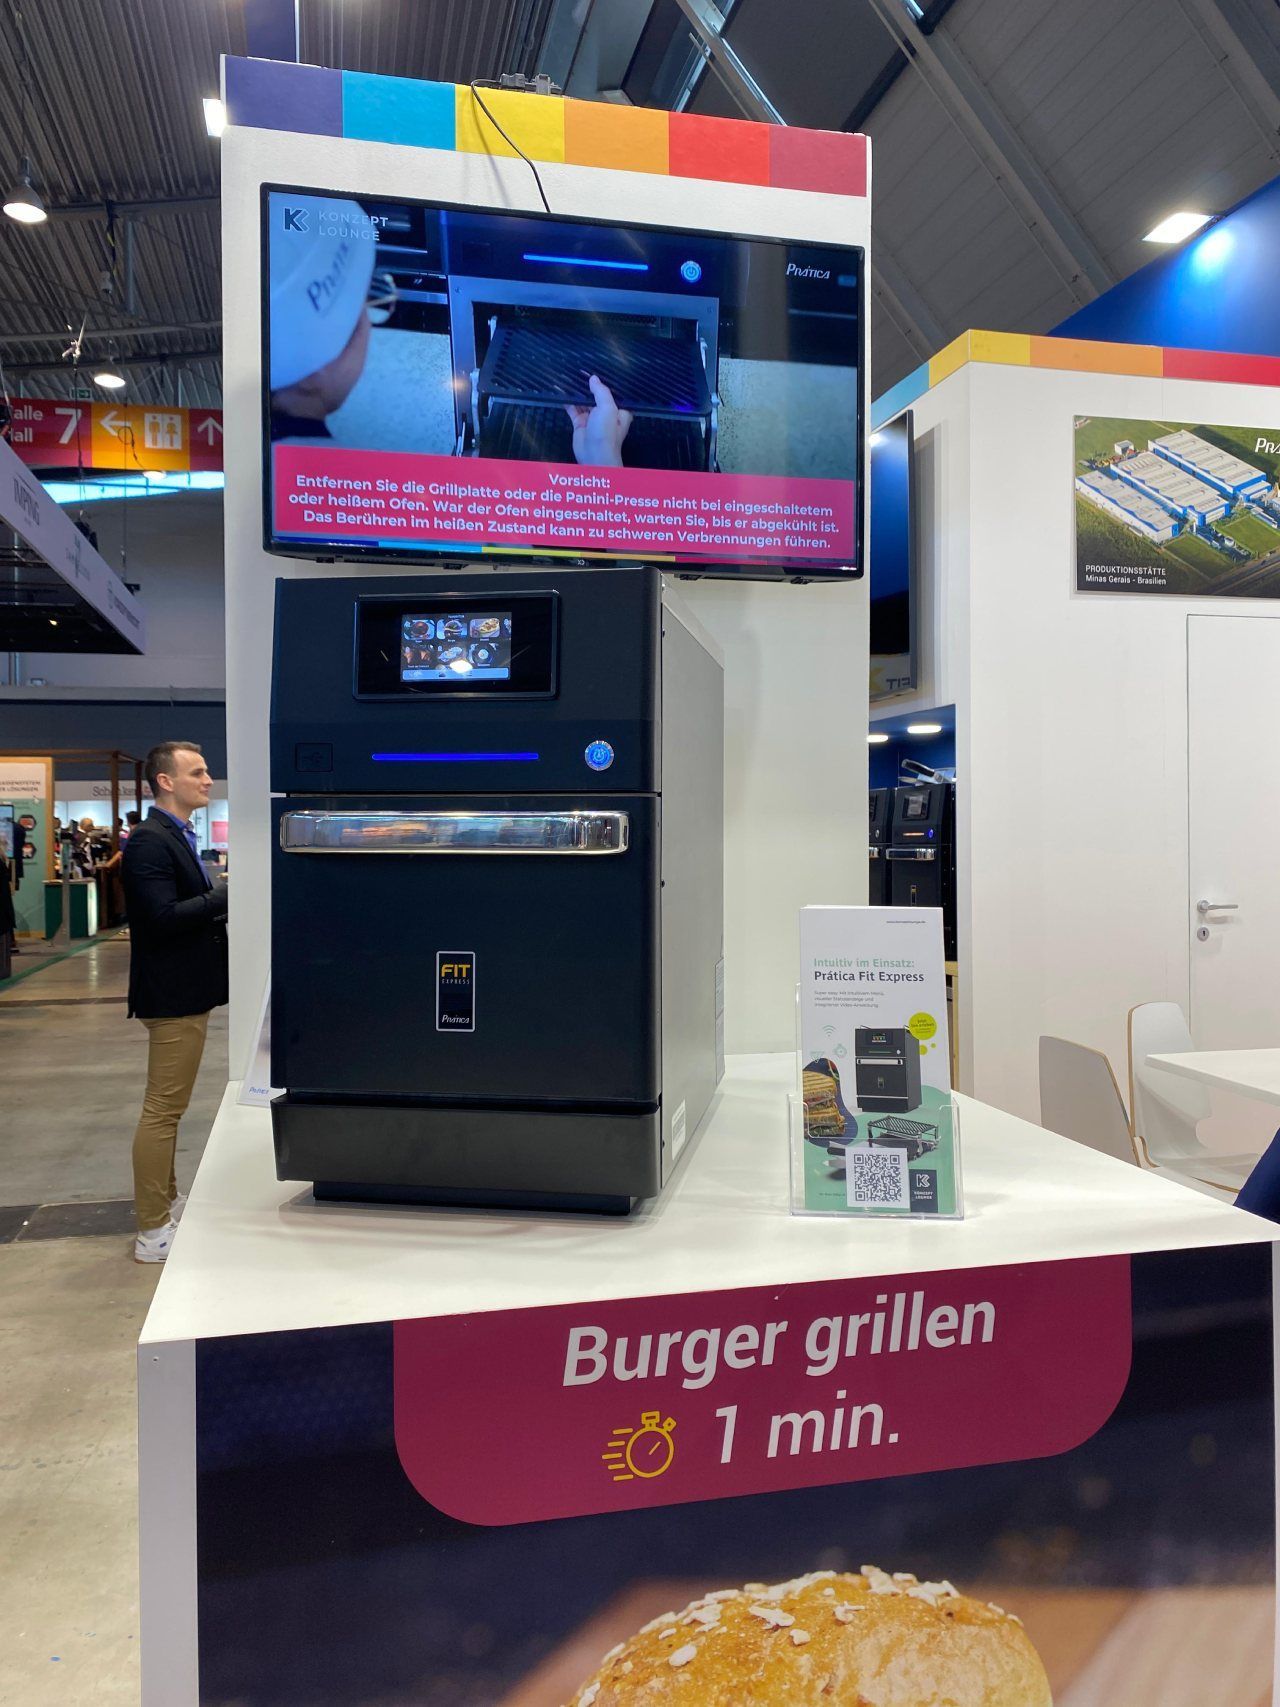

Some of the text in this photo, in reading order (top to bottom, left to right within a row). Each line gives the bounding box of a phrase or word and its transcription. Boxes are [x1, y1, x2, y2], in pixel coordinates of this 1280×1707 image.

[318, 211, 389, 227] KONZEPT
[319, 225, 380, 241] LOUNGE
[54, 407, 82, 444] 7
[548, 474, 611, 489] Vorsicht:
[296, 475, 833, 517] Entfernen Sie die Grillplatte oder die Panini-Presse nicht bei eingeschaltetem
[288, 492, 840, 533] oder heißem Ofen. War der Ofen eingeschaltet, warten Sie, bis er abgekühlt ist.
[304, 510, 831, 549] Das Berühren im heißen Zustand kann zu schweren Verbrennungen führen.
[1085, 564, 1166, 576] PRODUKTIONSSTÄTTE
[1085, 574, 1107, 583] Minas
[1108, 575, 1131, 584] Gerais
[1137, 576, 1167, 585] Brasilien
[441, 964, 471, 978] FIT
[814, 958, 915, 968] Intuitiv im Einsatz:
[814, 971, 925, 983] Prática Fit Express
[562, 1290, 996, 1390] Burger grillen
[715, 1389, 900, 1464] 1 min.
